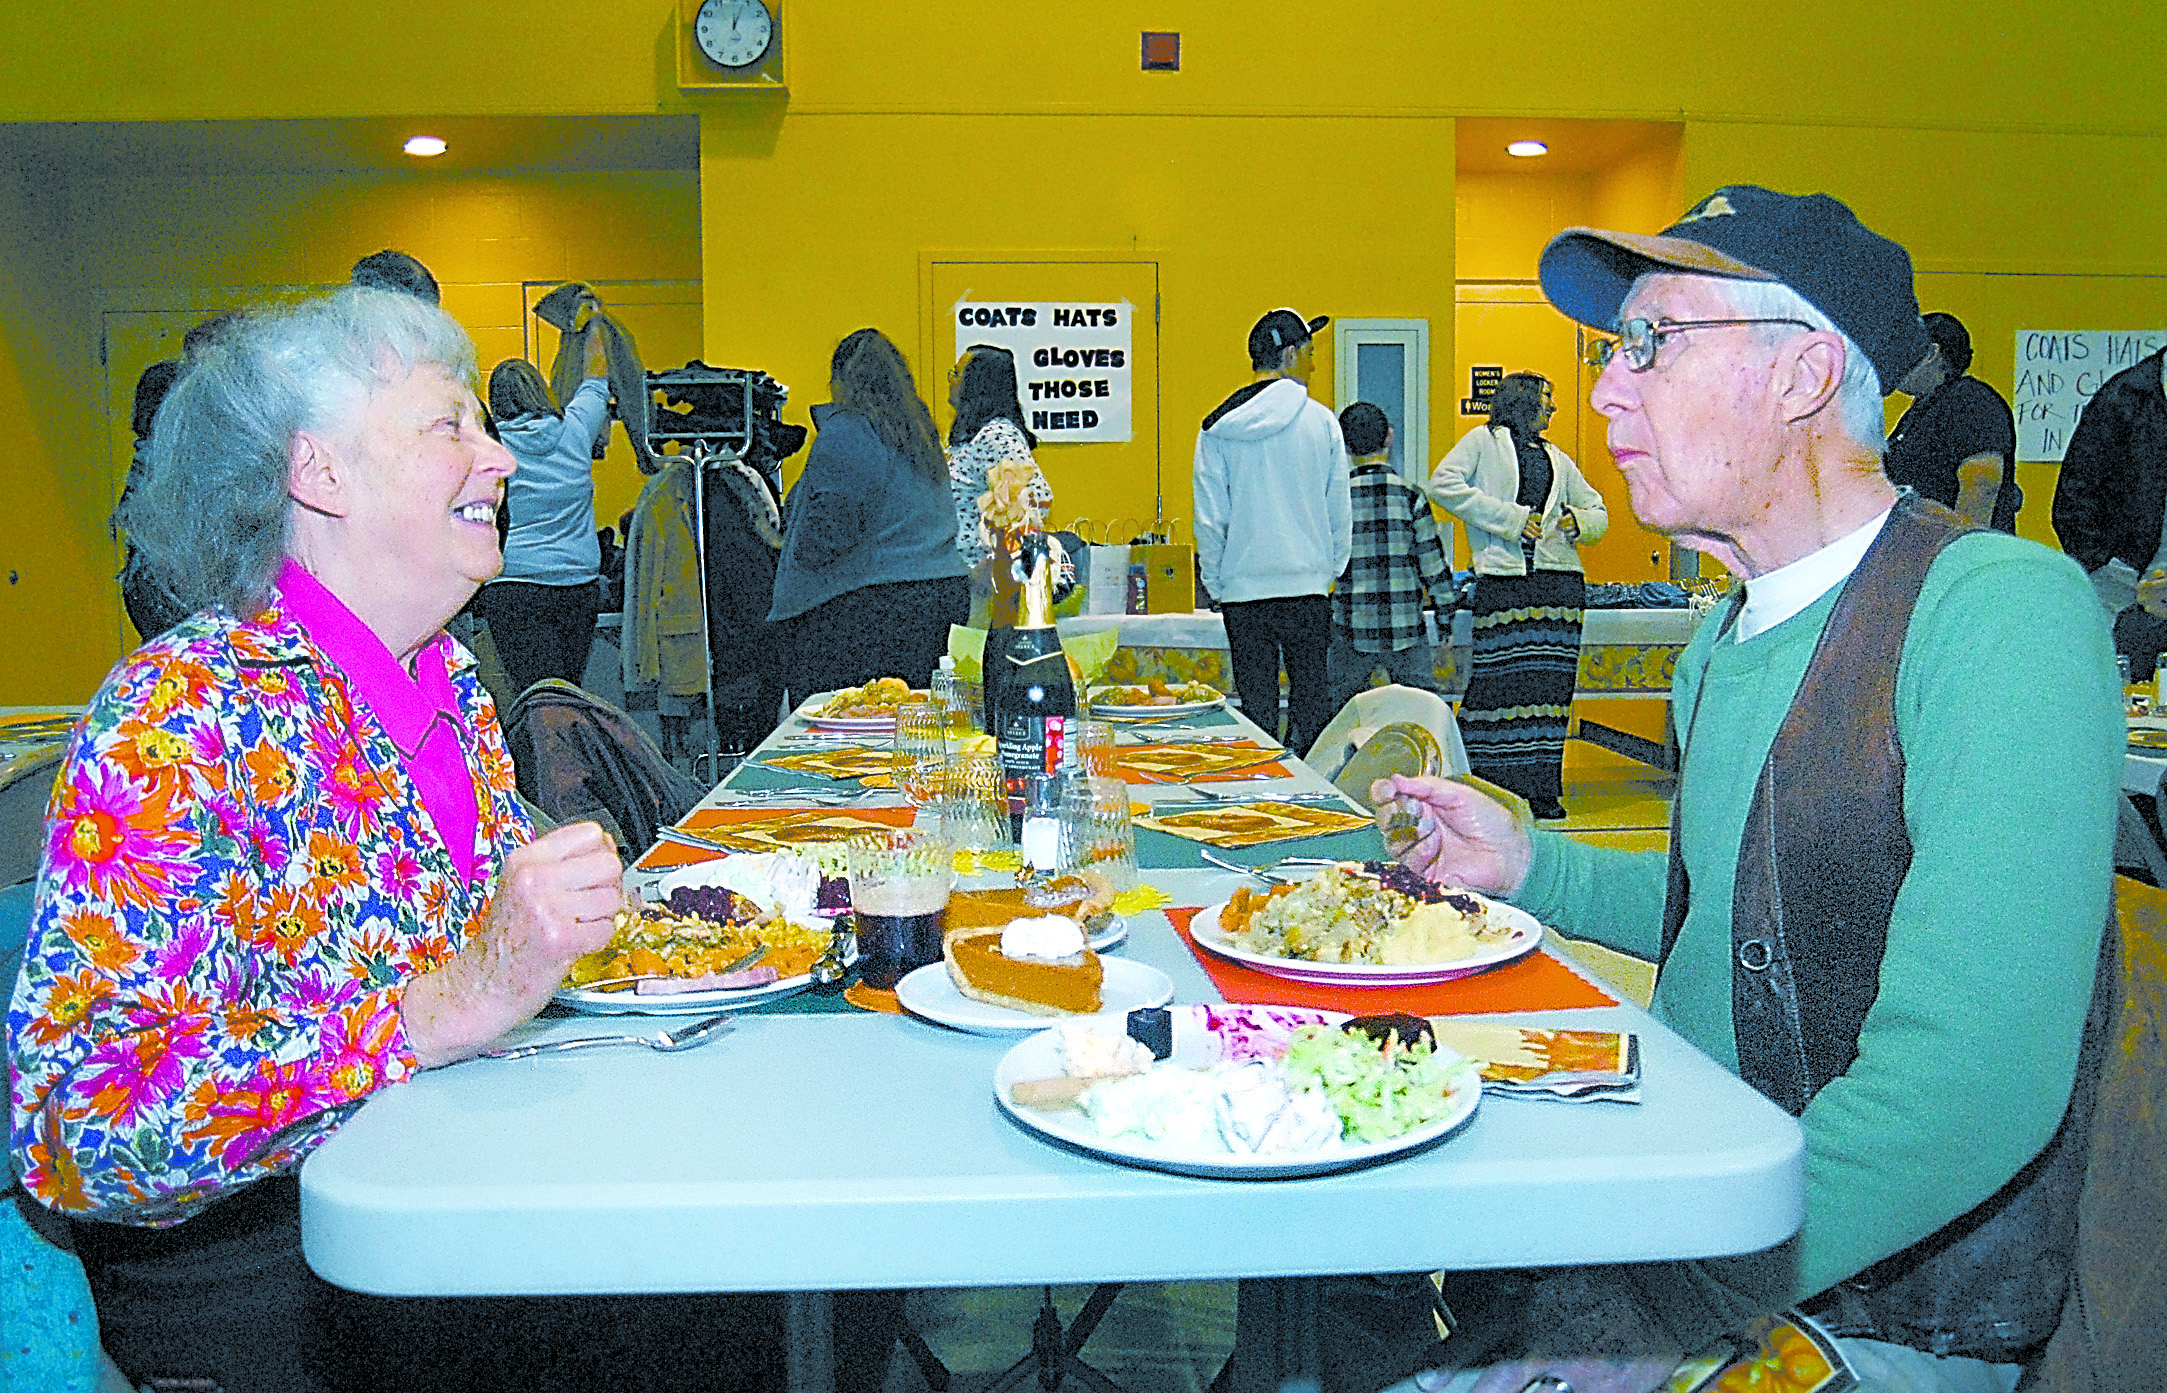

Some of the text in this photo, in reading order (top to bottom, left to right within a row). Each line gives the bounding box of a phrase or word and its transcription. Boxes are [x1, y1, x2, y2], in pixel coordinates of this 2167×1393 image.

[701, 26, 708, 34] 9
[760, 25, 767, 33] 3
[717, 51, 724, 59] 7
[732, 55, 738, 63] 6
[958, 307, 1118, 327] COATS HATS
[1033, 347, 1125, 368] GLOVES
[2026, 333, 2089, 364] COATS
[1028, 379, 1110, 401] THOSE
[2016, 369, 2065, 397] AND
[1031, 409, 1099, 430] NEED
[2017, 399, 2066, 425] FOR
[2043, 428, 2062, 453] IN
[1022, 743, 1043, 753] Apple
